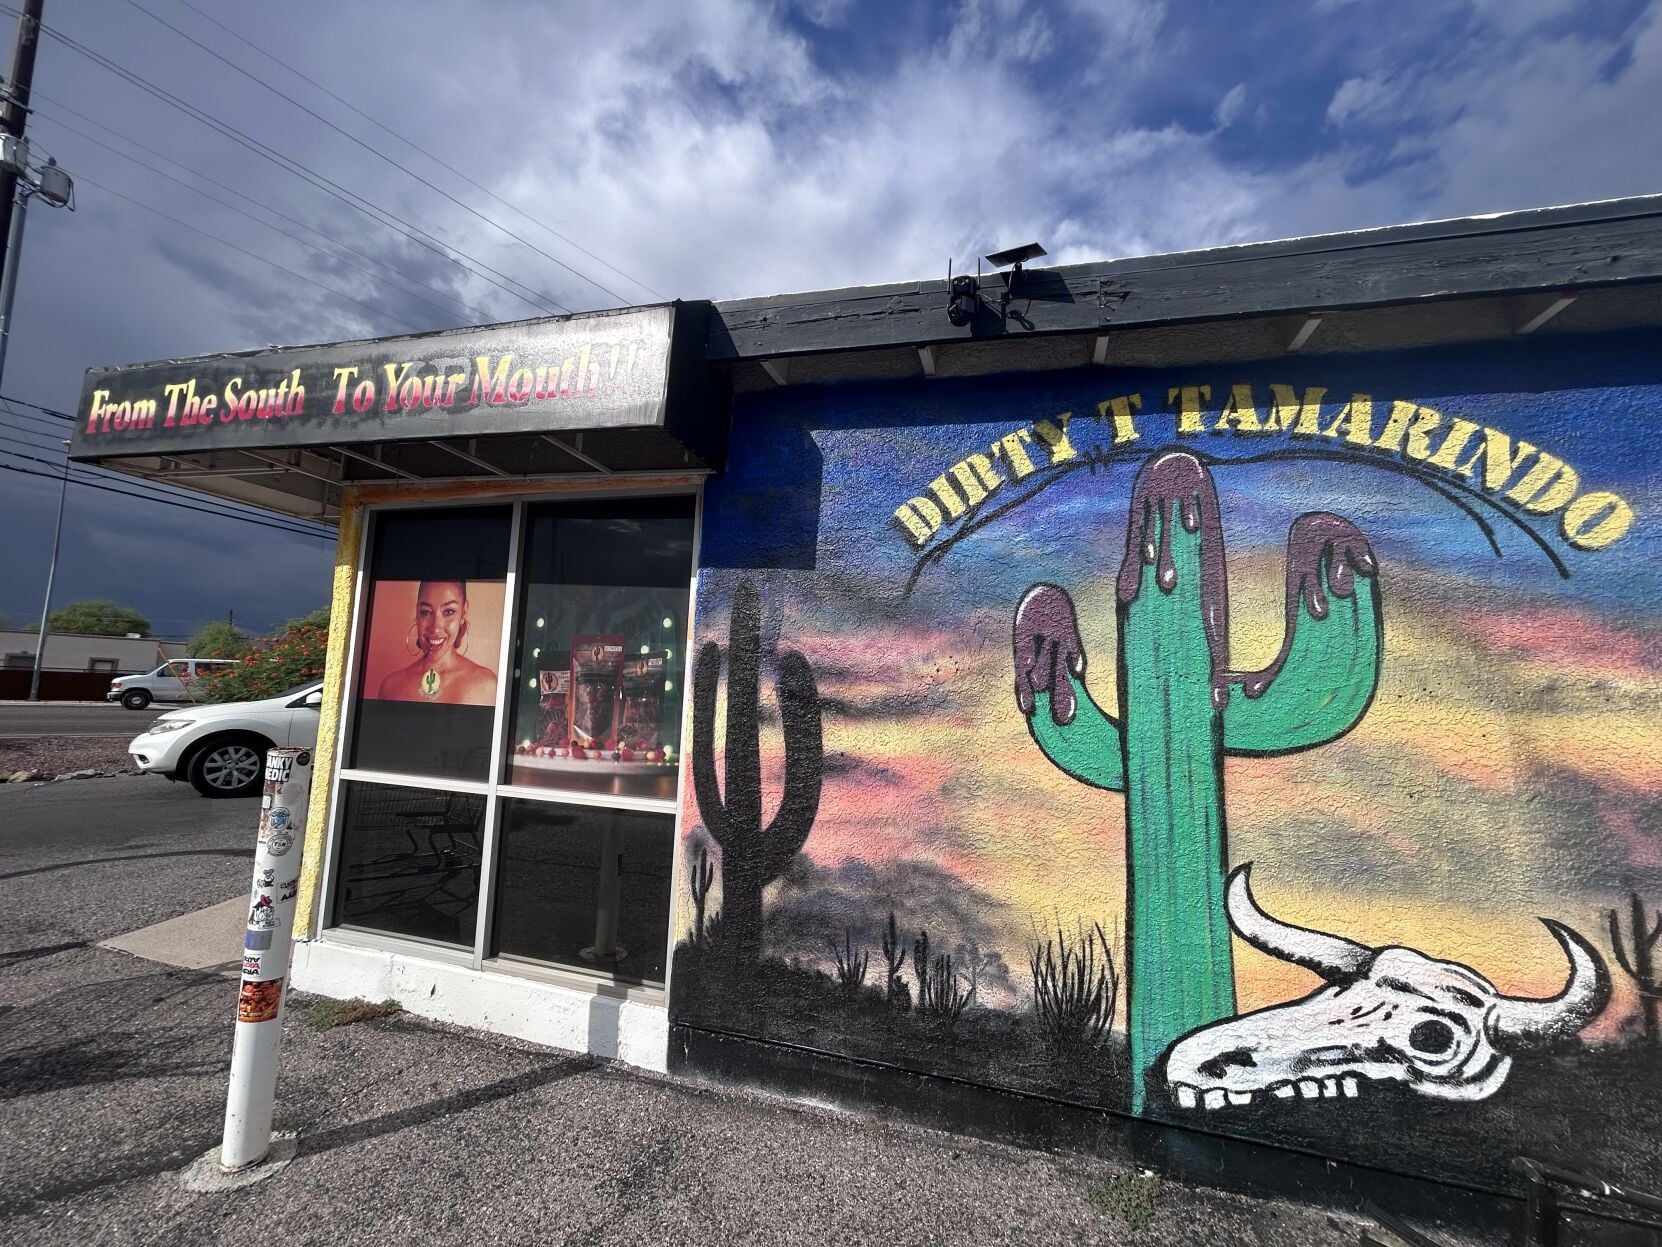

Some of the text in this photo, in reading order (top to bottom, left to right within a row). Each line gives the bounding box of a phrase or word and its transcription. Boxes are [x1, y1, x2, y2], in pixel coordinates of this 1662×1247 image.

[85, 390, 156, 434] From
[163, 378, 217, 428] The
[220, 368, 305, 423] South
[331, 366, 376, 414] To
[383, 361, 466, 410] Your
[894, 383, 1637, 553] DIRTY T TAMARINDO
